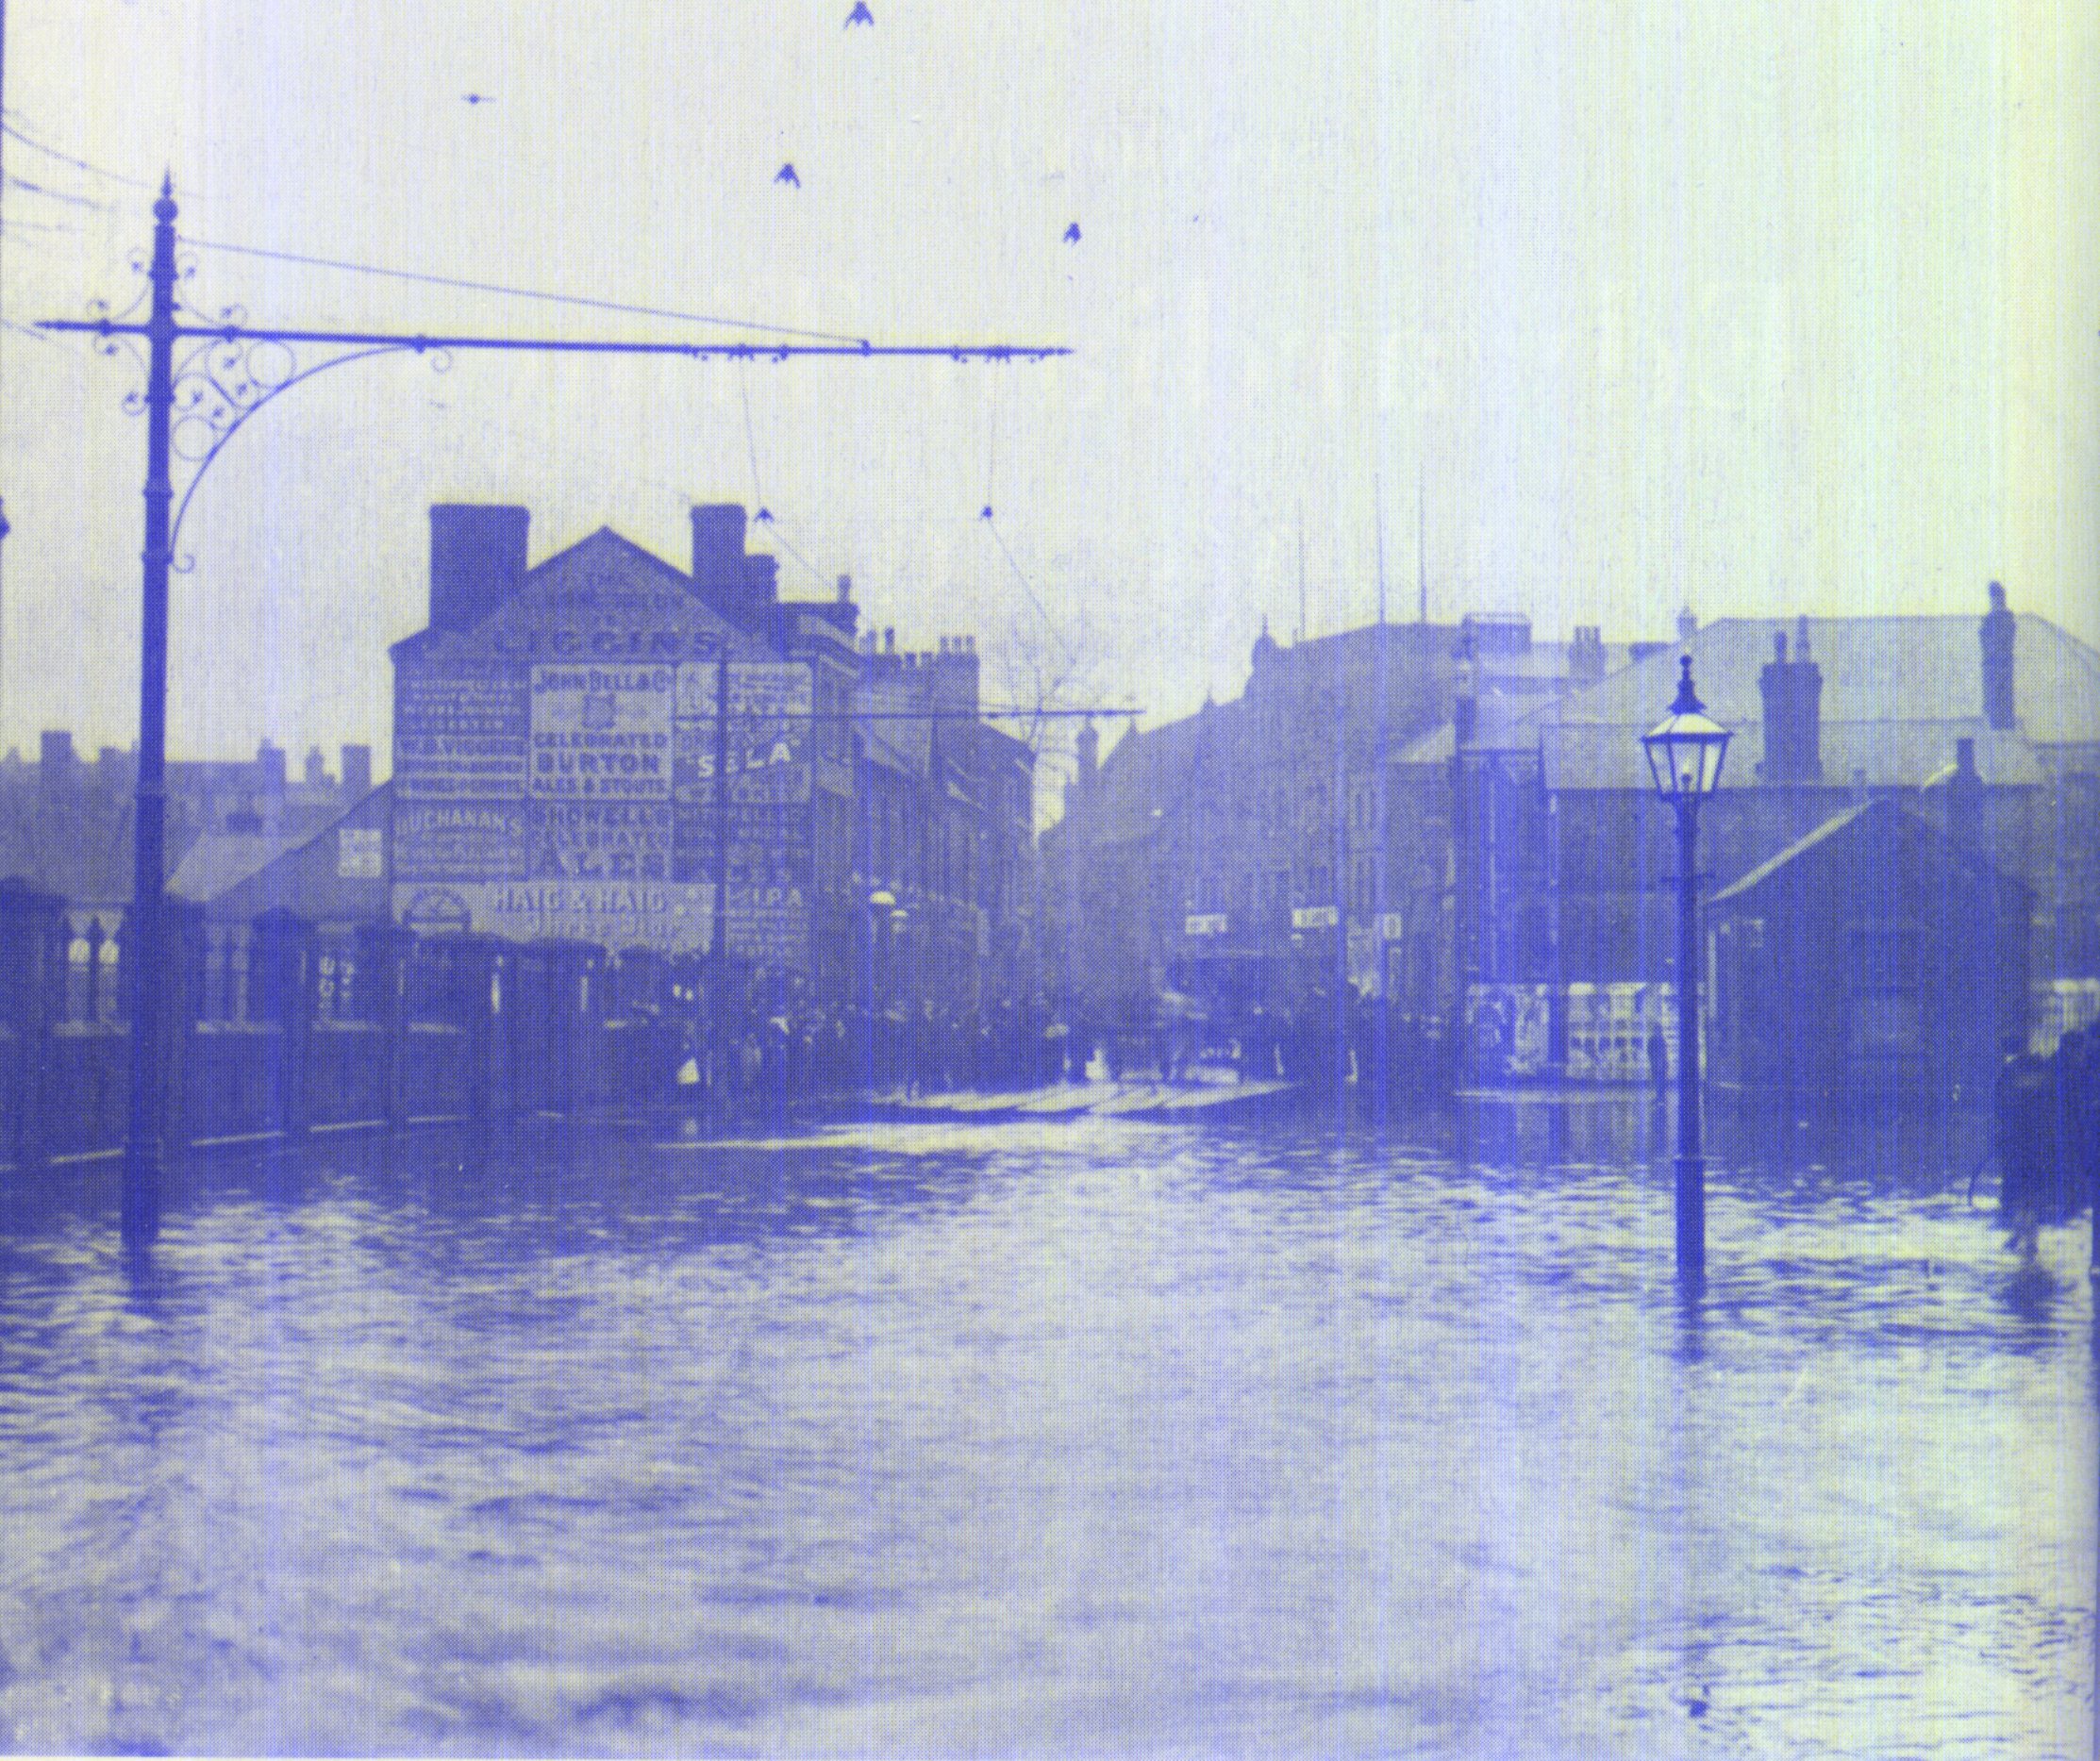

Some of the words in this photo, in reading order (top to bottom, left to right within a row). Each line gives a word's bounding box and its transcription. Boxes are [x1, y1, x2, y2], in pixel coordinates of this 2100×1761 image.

[533, 670, 586, 694] JOHN
[533, 733, 667, 749] CELEBRATED
[536, 753, 661, 774] BURTON
[532, 777, 577, 793] ALES
[599, 778, 666, 794] STOUTS
